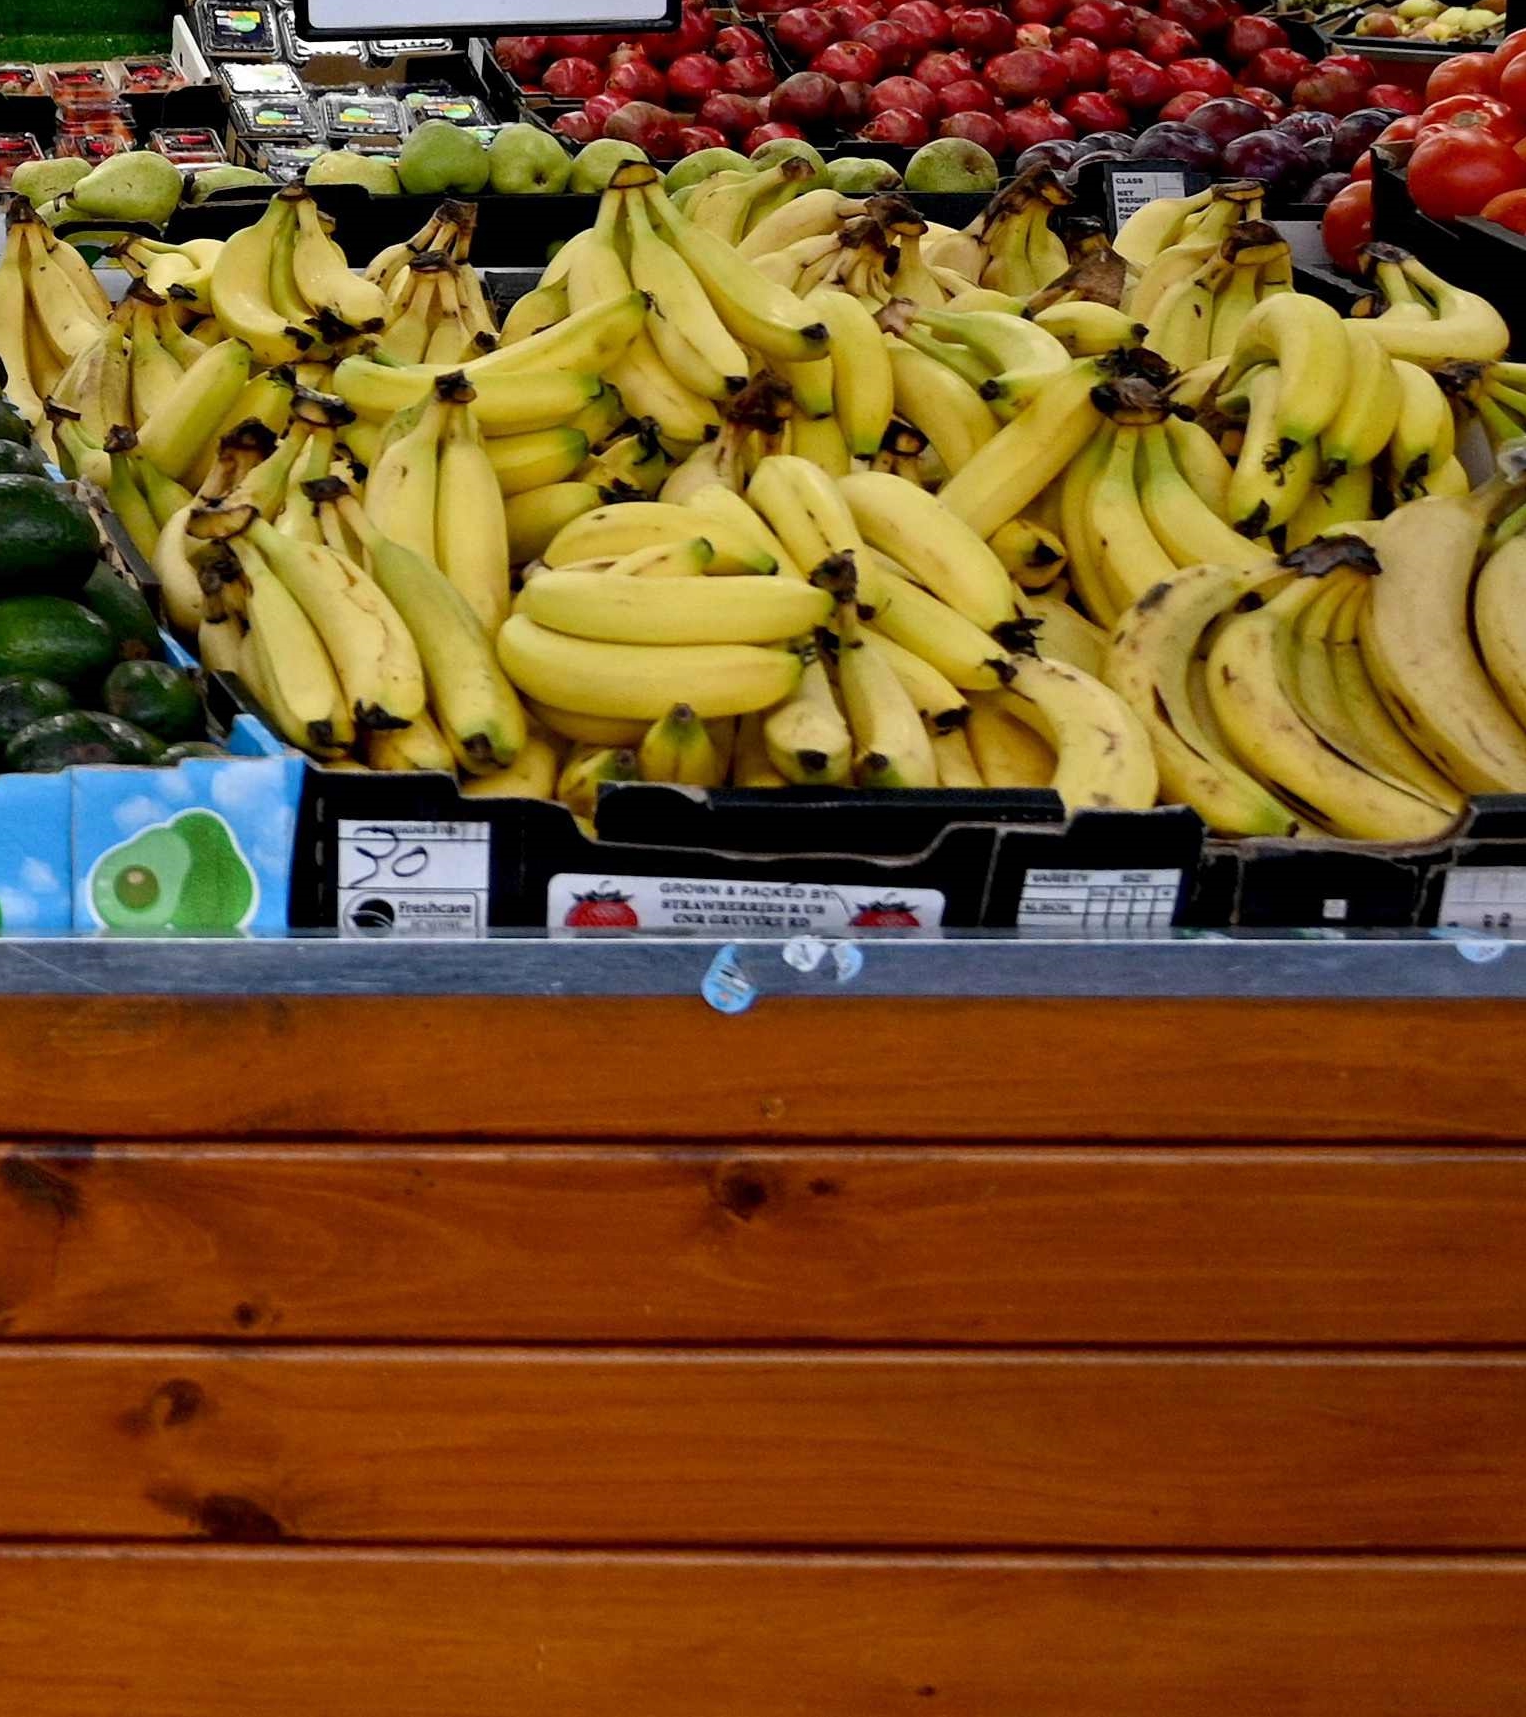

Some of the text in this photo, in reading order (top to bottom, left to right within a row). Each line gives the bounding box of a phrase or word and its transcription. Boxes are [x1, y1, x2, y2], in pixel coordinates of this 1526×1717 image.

[659, 882, 720, 895] GROWN
[741, 885, 806, 898] PACKED
[399, 900, 471, 914] Freshcare
